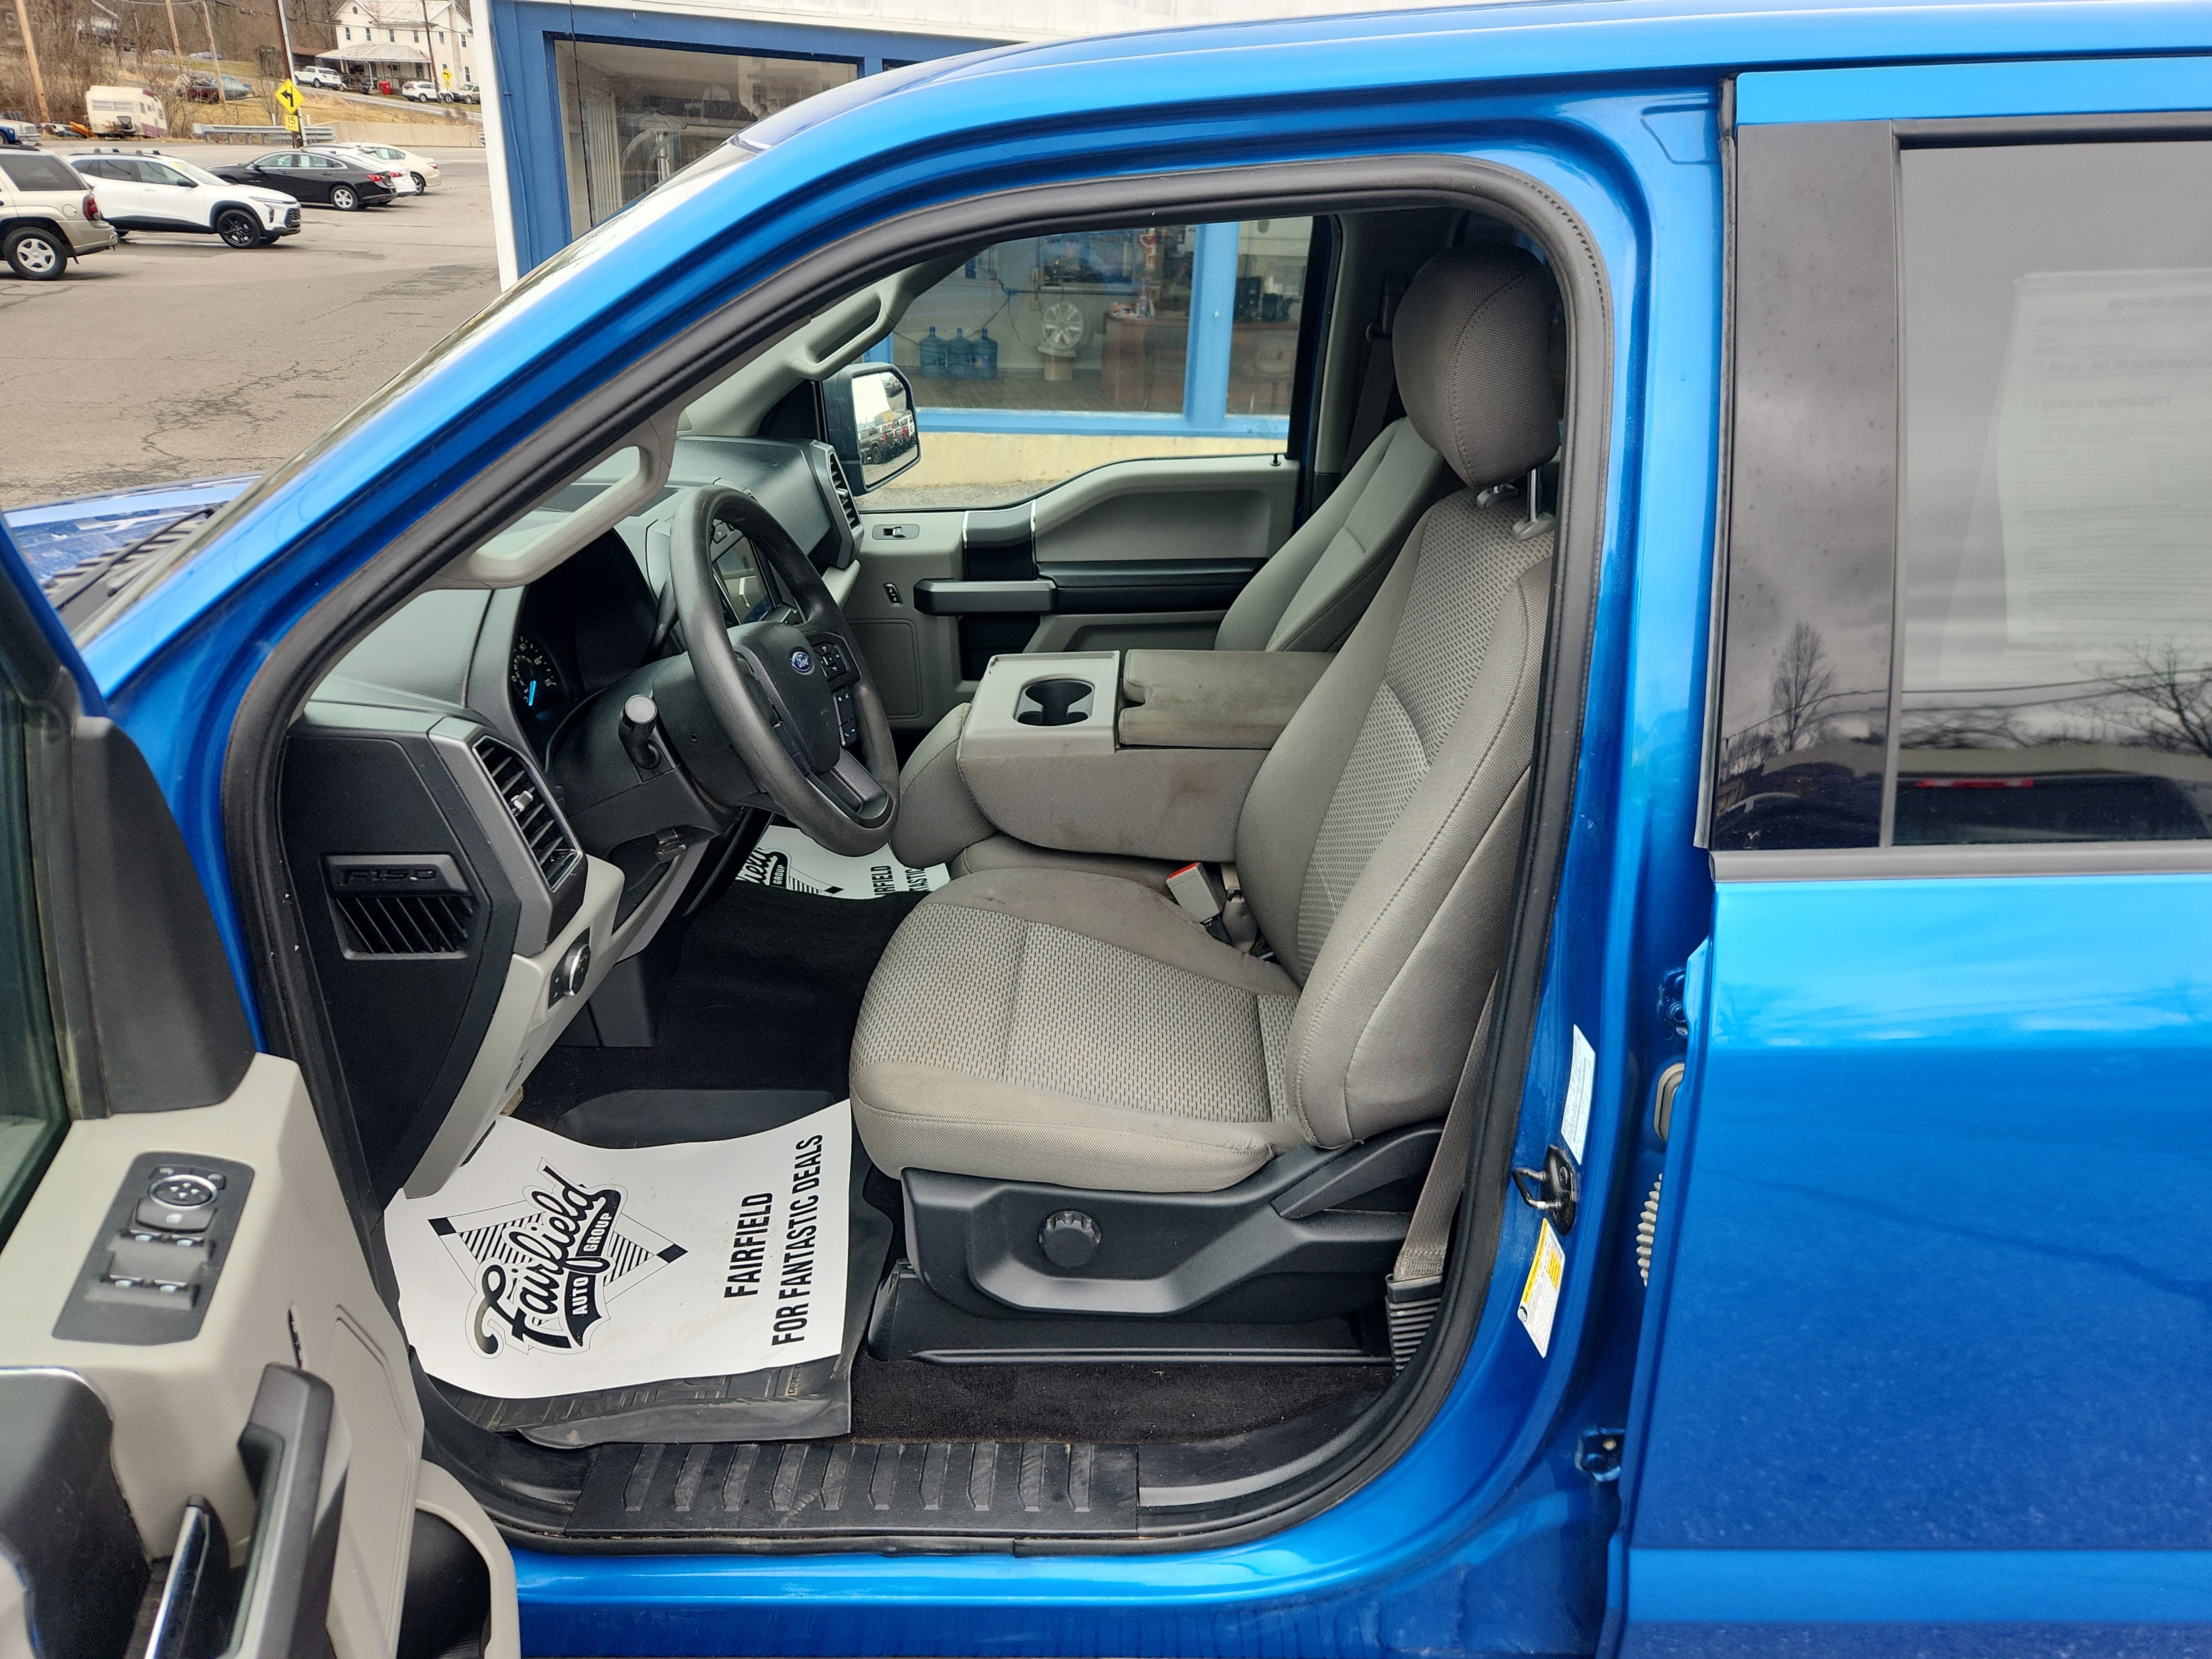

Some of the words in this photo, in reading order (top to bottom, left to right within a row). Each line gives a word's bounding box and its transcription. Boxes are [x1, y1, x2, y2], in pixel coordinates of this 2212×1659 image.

[288, 116, 295, 124] 15
[2041, 398, 2094, 410] DEALER
[2096, 396, 2173, 408] WARRANTY
[773, 864, 785, 884] GROUP
[870, 865, 896, 896] IRFIELD
[792, 1134, 823, 1194] DEALS
[474, 1165, 611, 1354] Fairfield
[572, 1277, 589, 1315] AUTO
[583, 1212, 613, 1252] GROUP
[724, 1192, 773, 1298] FAIRFIELD
[778, 1194, 819, 1300] FANTASTIC
[771, 1302, 809, 1346] FOR
